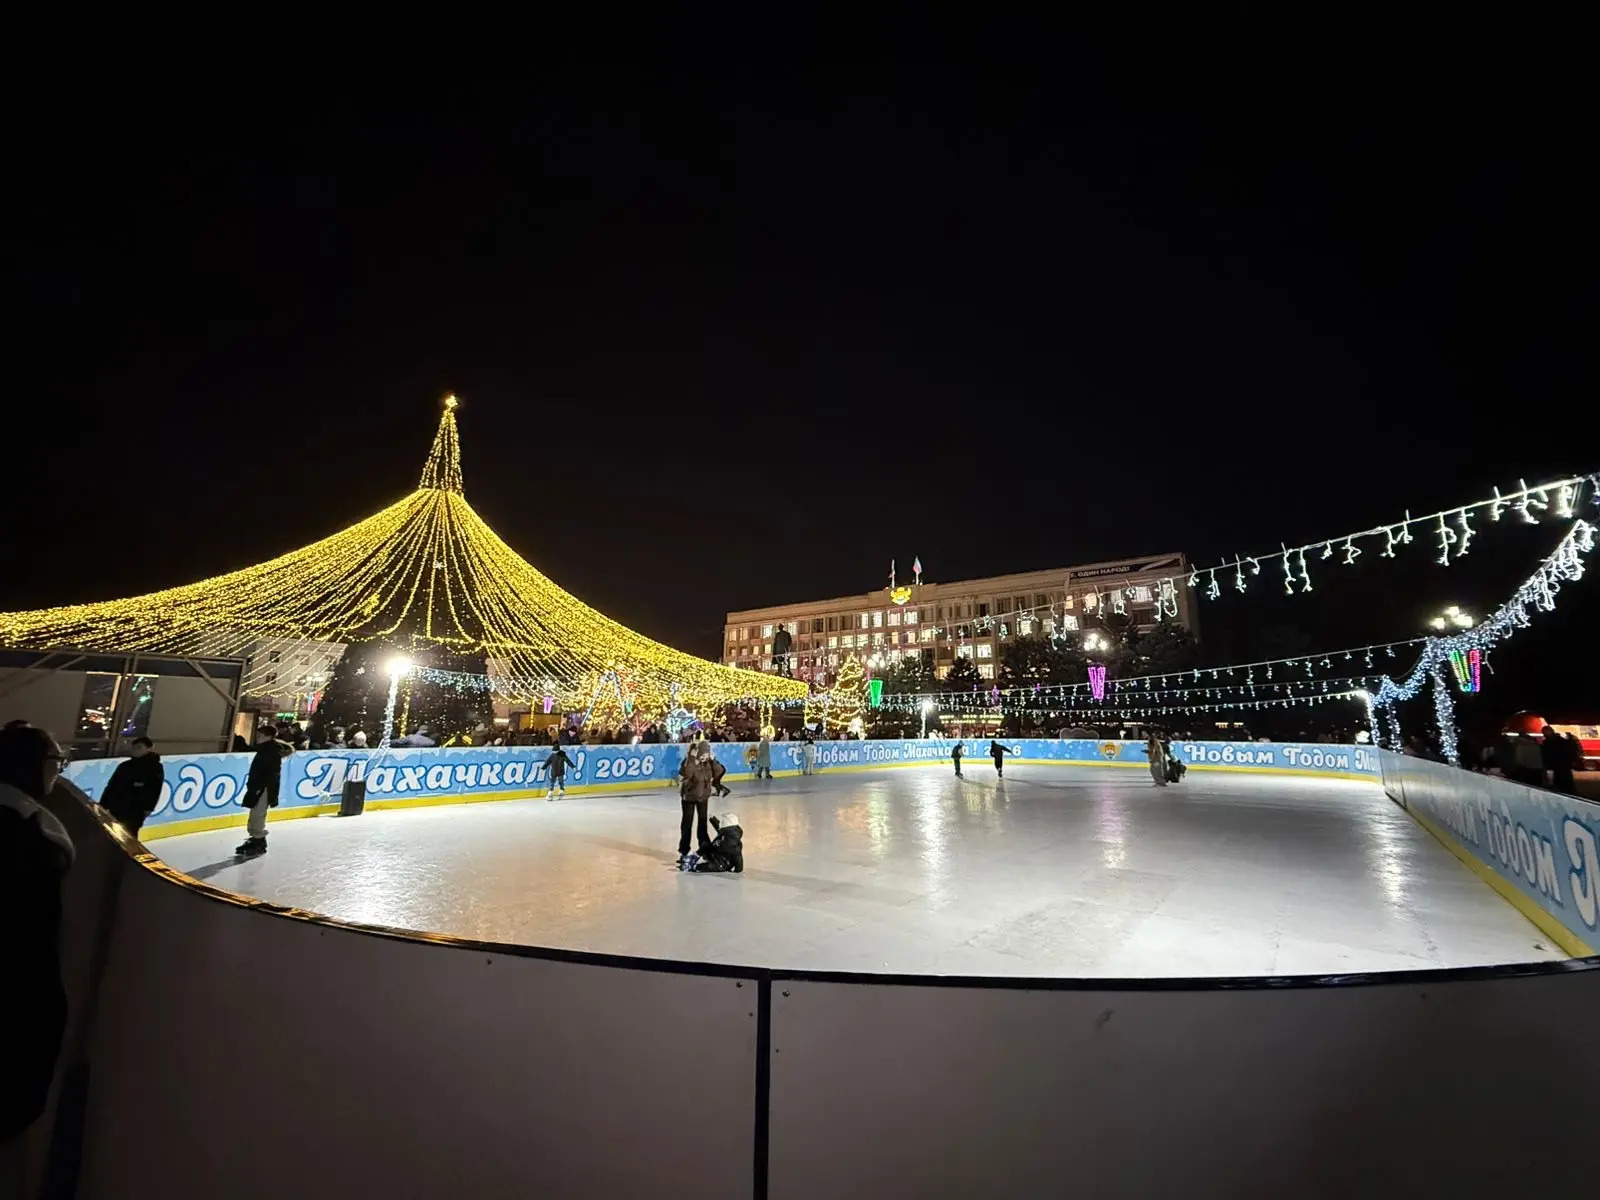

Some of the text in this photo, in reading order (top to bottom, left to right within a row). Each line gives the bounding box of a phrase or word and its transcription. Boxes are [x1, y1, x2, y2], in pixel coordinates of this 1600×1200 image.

[1100, 566, 1130, 574] НАРОД!
[812, 743, 859, 764] Новым
[863, 743, 900, 761] Годом
[902, 742, 978, 759] Махачкаа!
[983, 744, 1022, 757] 26
[1183, 743, 1274, 764] Новым
[1282, 746, 1349, 769] Годом
[297, 752, 586, 799] Махачкал!
[594, 754, 655, 780] 2026
